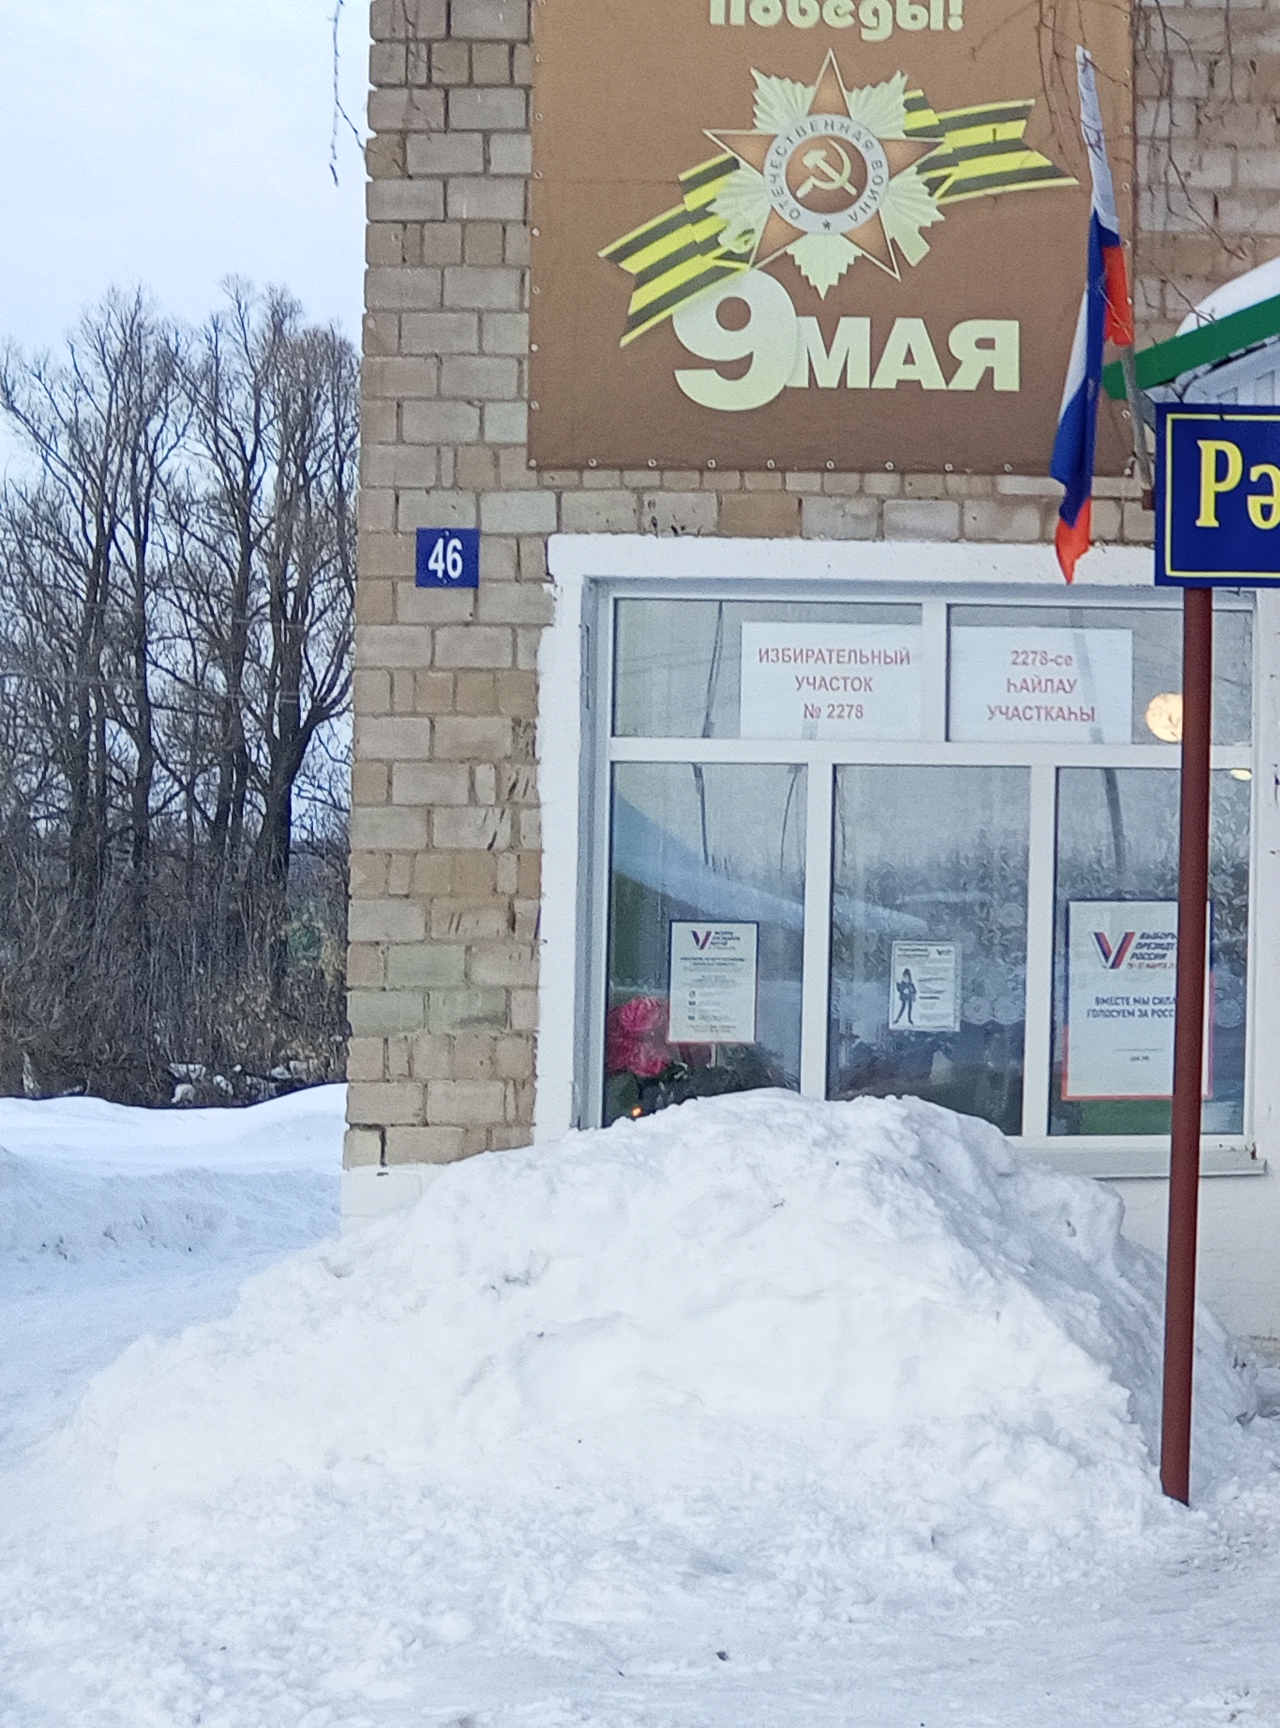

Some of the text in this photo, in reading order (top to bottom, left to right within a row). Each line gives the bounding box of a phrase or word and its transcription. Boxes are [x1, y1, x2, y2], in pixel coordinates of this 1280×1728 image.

[672, 267, 1020, 412] 9 МАЯ
[428, 537, 463, 579] 46
[758, 646, 911, 666] ИЗБИРАТЕЛЬНЫЙ
[1010, 650, 1073, 666] 2278-се
[795, 675, 873, 693] УЧАСТОК
[803, 704, 864, 720] № 2278
[1151, 1008, 1175, 1019] РОСС
